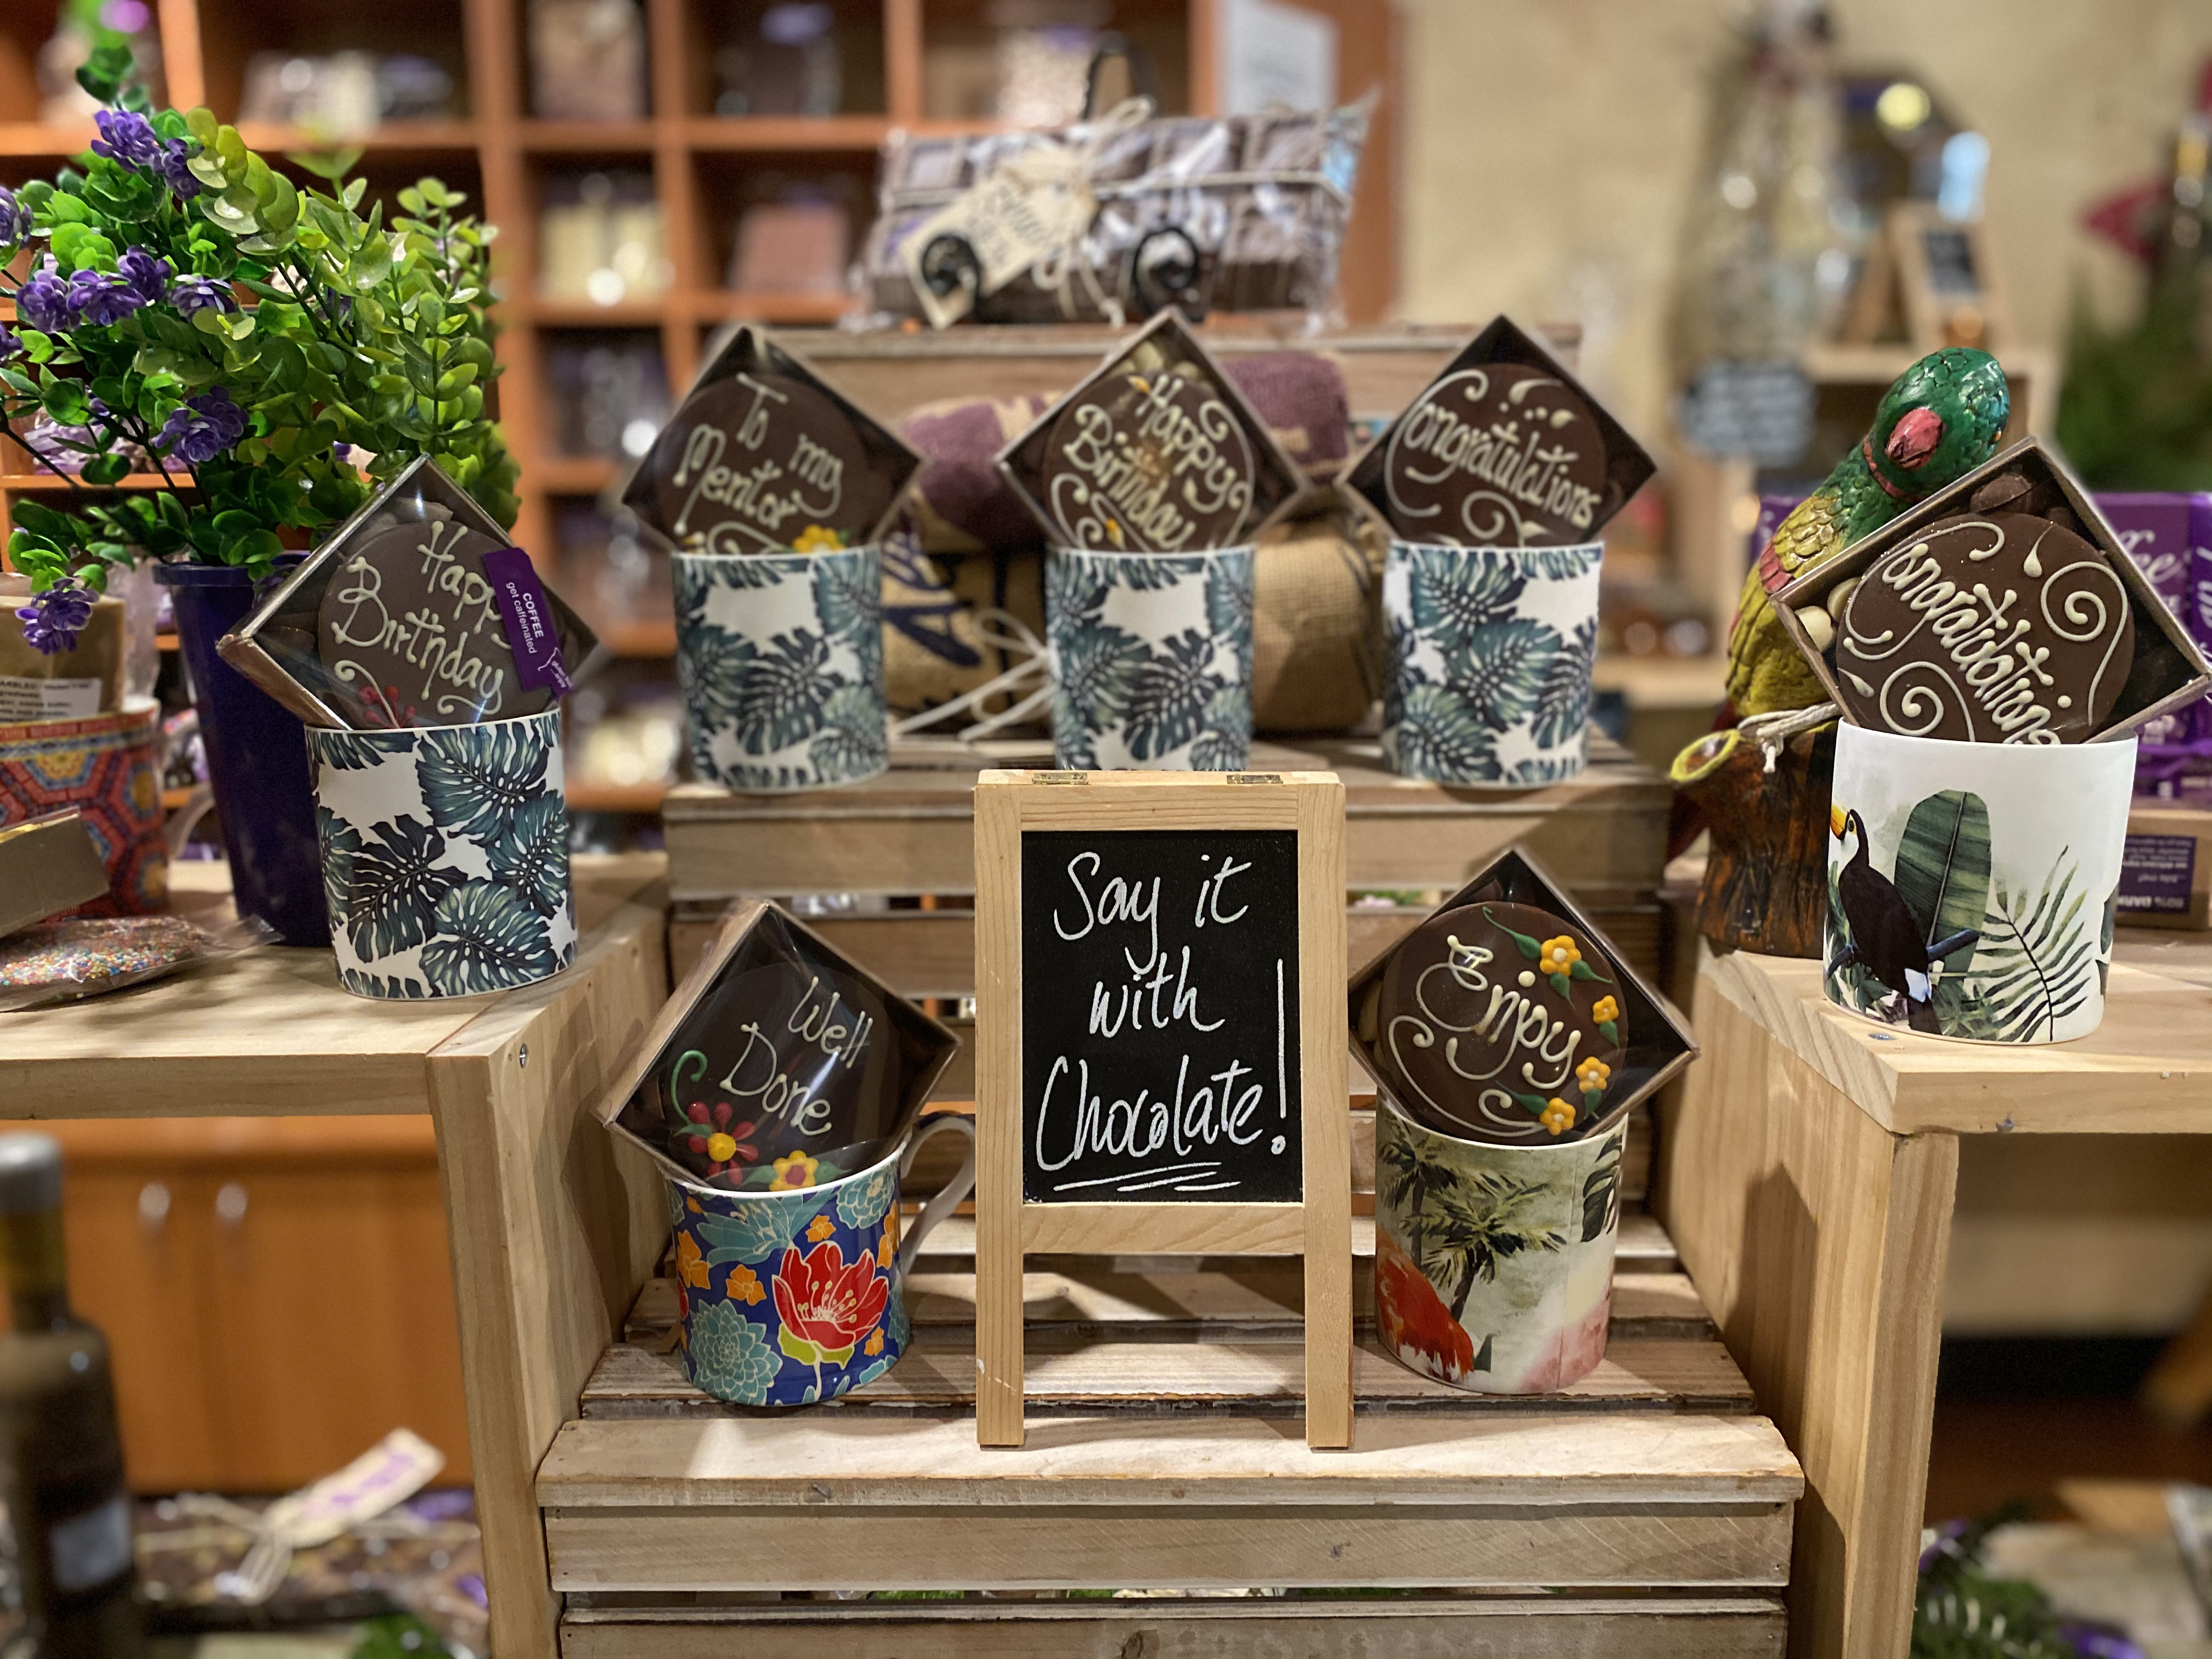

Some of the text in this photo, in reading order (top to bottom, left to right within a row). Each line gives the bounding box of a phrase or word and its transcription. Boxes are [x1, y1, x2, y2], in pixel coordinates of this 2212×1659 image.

[673, 423, 799, 537] Mentor
[737, 371, 844, 519] To my
[1135, 374, 1238, 515] Happy
[331, 556, 504, 714] Birthday
[417, 521, 511, 650] Happ
[506, 582, 538, 654] get caffeinated
[523, 592, 544, 638] COFFEE
[1053, 851, 1252, 975] Say it
[788, 975, 874, 1070] Well
[1089, 945, 1226, 1039] with
[1415, 935, 1582, 1090] Enjoy
[719, 1022, 832, 1136] Done
[1036, 958, 1287, 1171] Chocolate!
